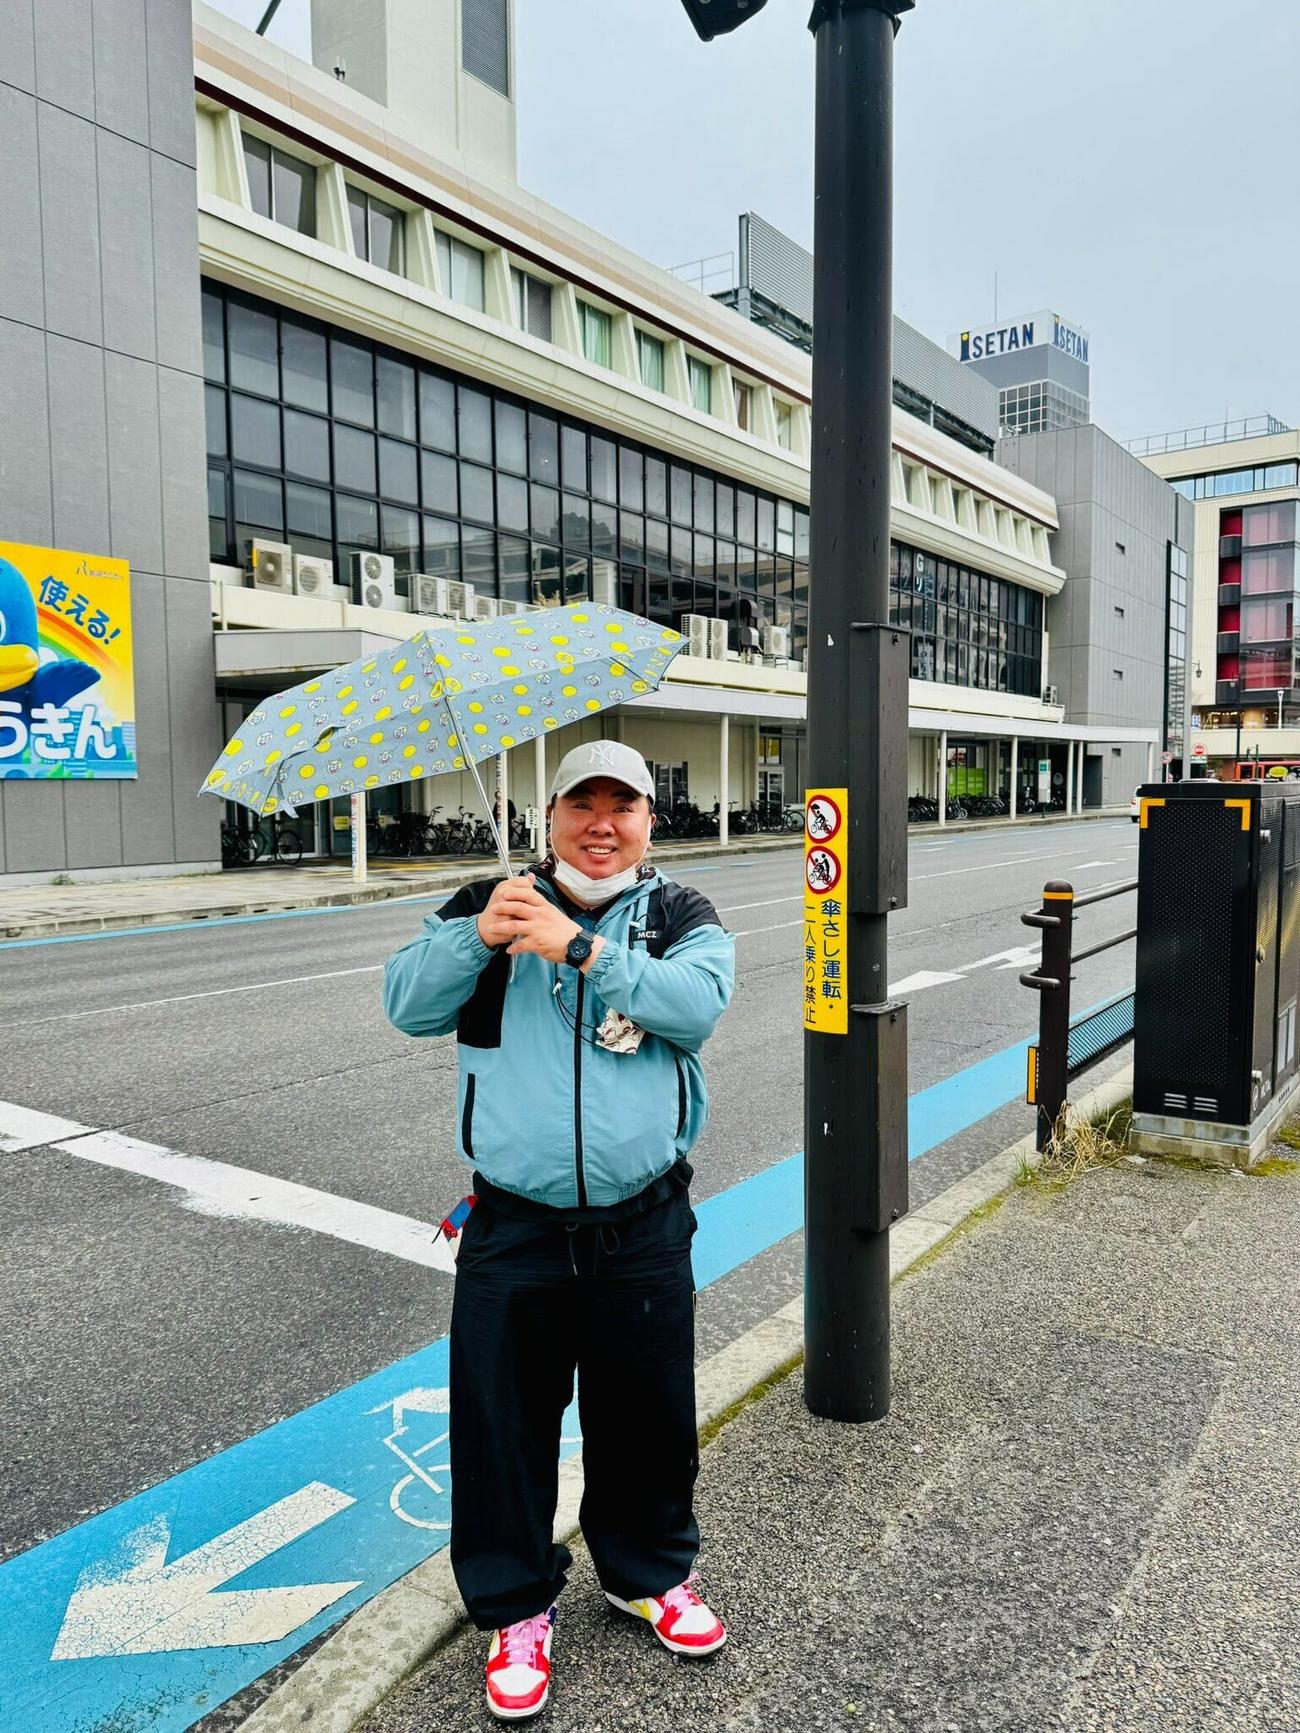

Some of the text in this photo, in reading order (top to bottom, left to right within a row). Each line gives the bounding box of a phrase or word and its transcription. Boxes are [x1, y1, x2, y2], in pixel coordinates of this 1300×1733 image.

[960, 321, 1034, 362] ISETAN
[39, 575, 121, 645] 使える!
[589, 744, 616, 769] NY
[637, 930, 657, 939] MCZ
[805, 905, 816, 1024] 二人乗り禁止
